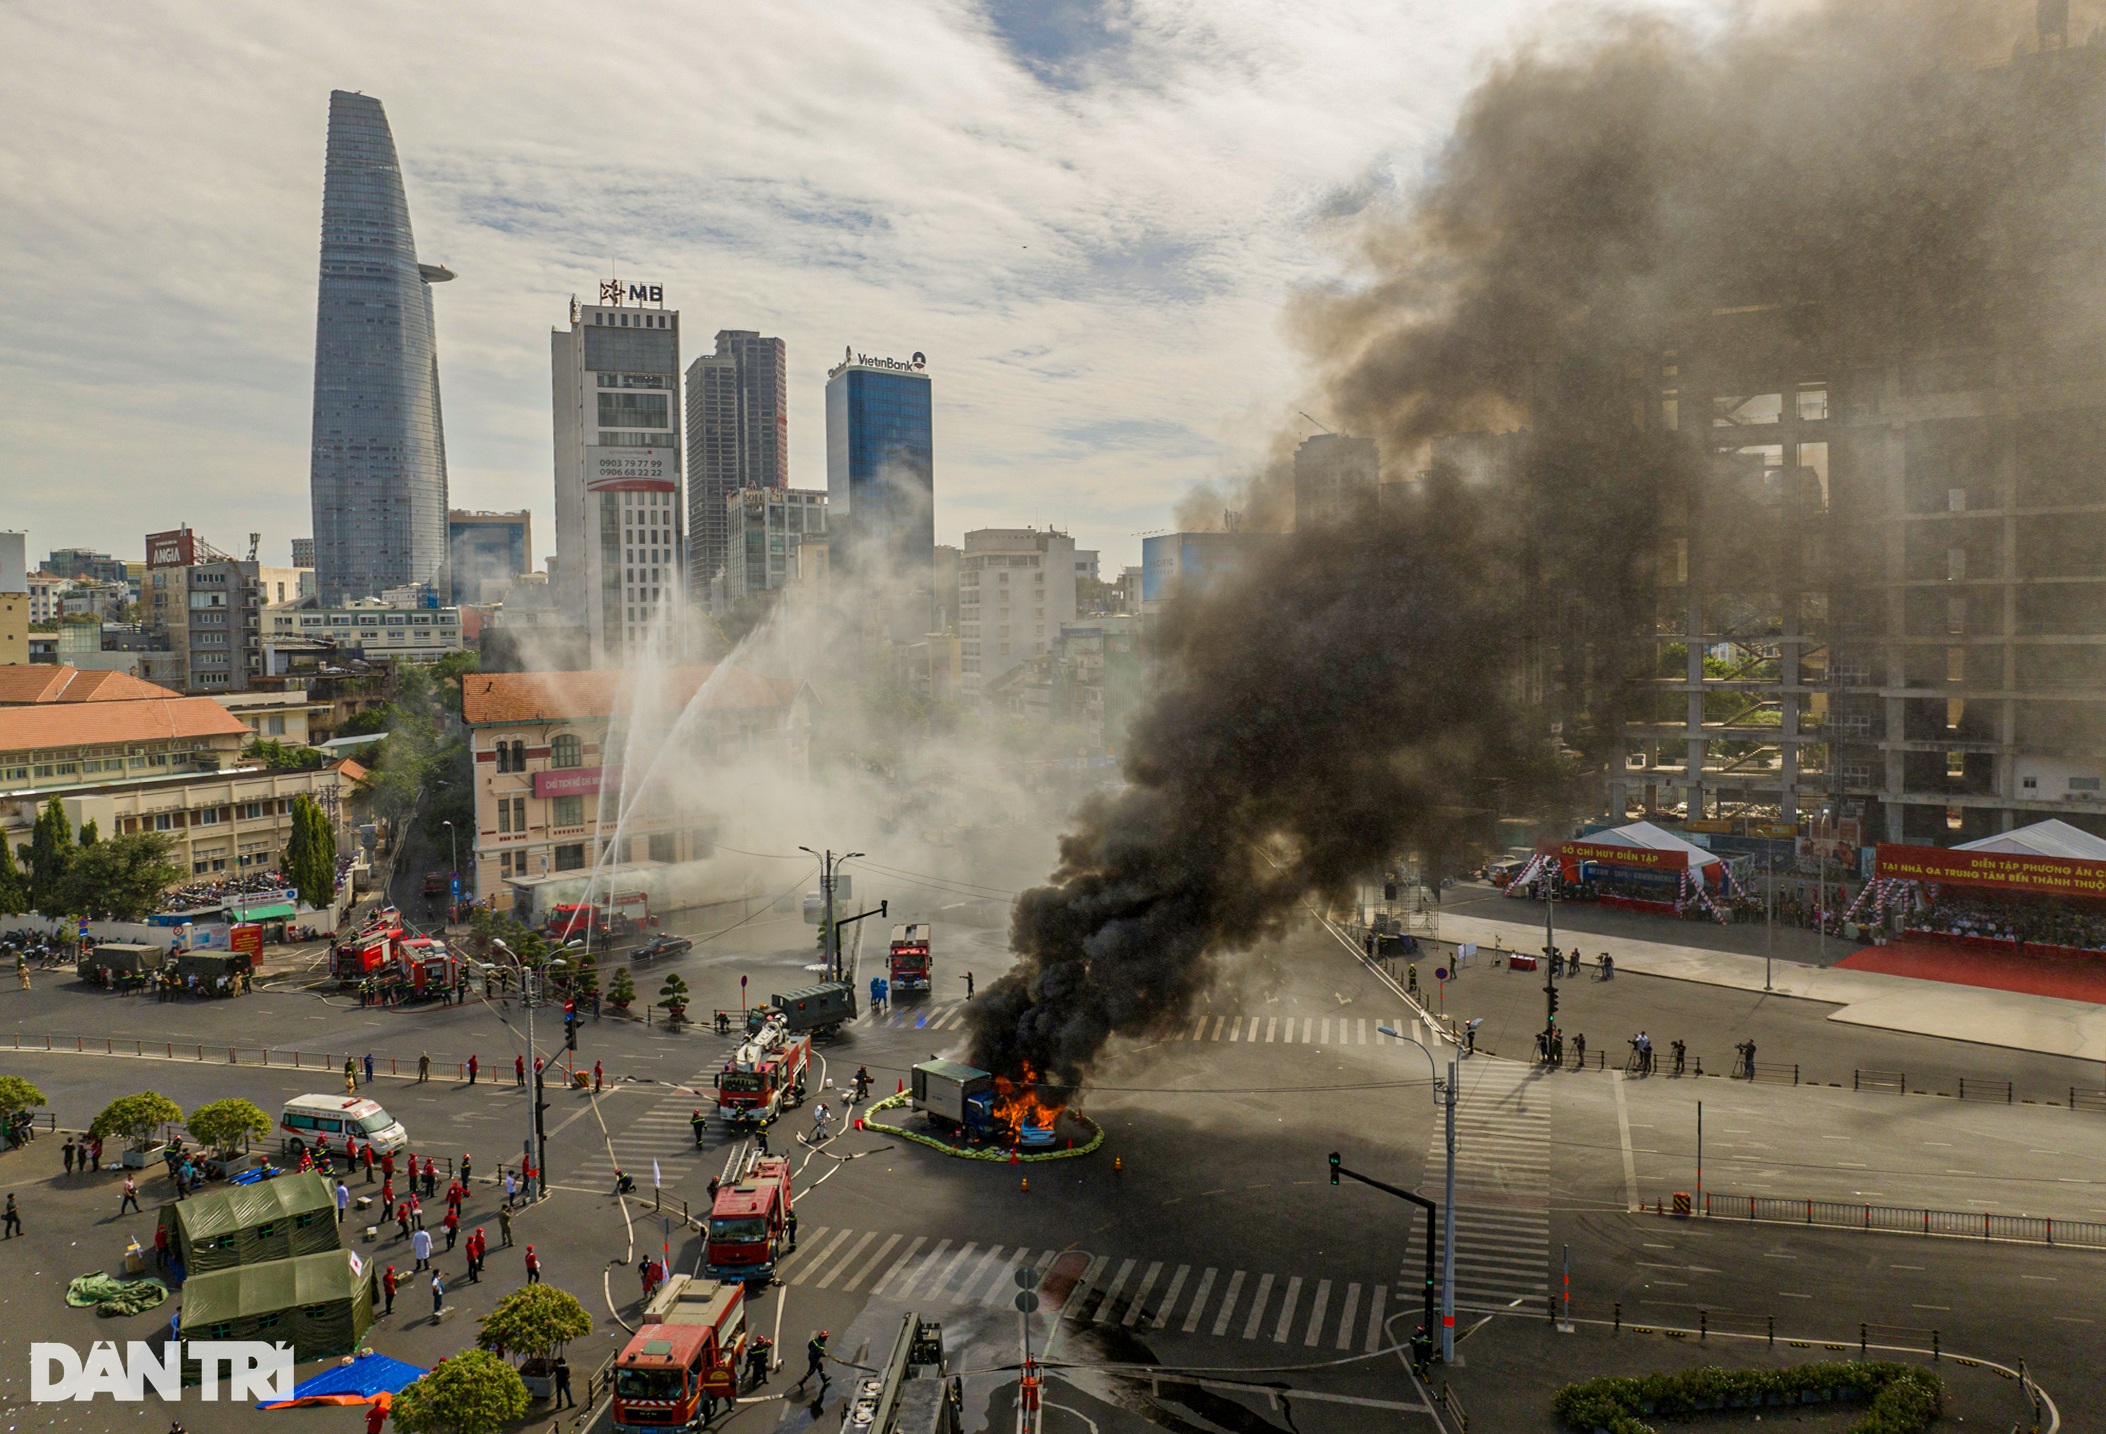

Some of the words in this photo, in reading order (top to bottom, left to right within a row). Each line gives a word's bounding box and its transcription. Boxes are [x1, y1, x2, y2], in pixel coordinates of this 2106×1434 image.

[629, 285, 662, 301] MB
[858, 353, 913, 371] VietinBank
[651, 469, 662, 477] 22
[1562, 845, 1575, 855] SỞ
[1641, 854, 1659, 864] TẬP
[1882, 862, 1898, 871] TẠI
[1901, 864, 1922, 873] NHÀ
[1926, 866, 1941, 875] GA
[1945, 868, 1979, 878] TRUNG
[1983, 870, 2005, 880] TÂM
[2009, 872, 2029, 882] BẾN
[2032, 875, 2070, 886] THÀNH
[1999, 860, 2019, 871] TẬP
[2023, 863, 2071, 875] PHƯƠNG
[2075, 866, 2092, 876] ÁN
